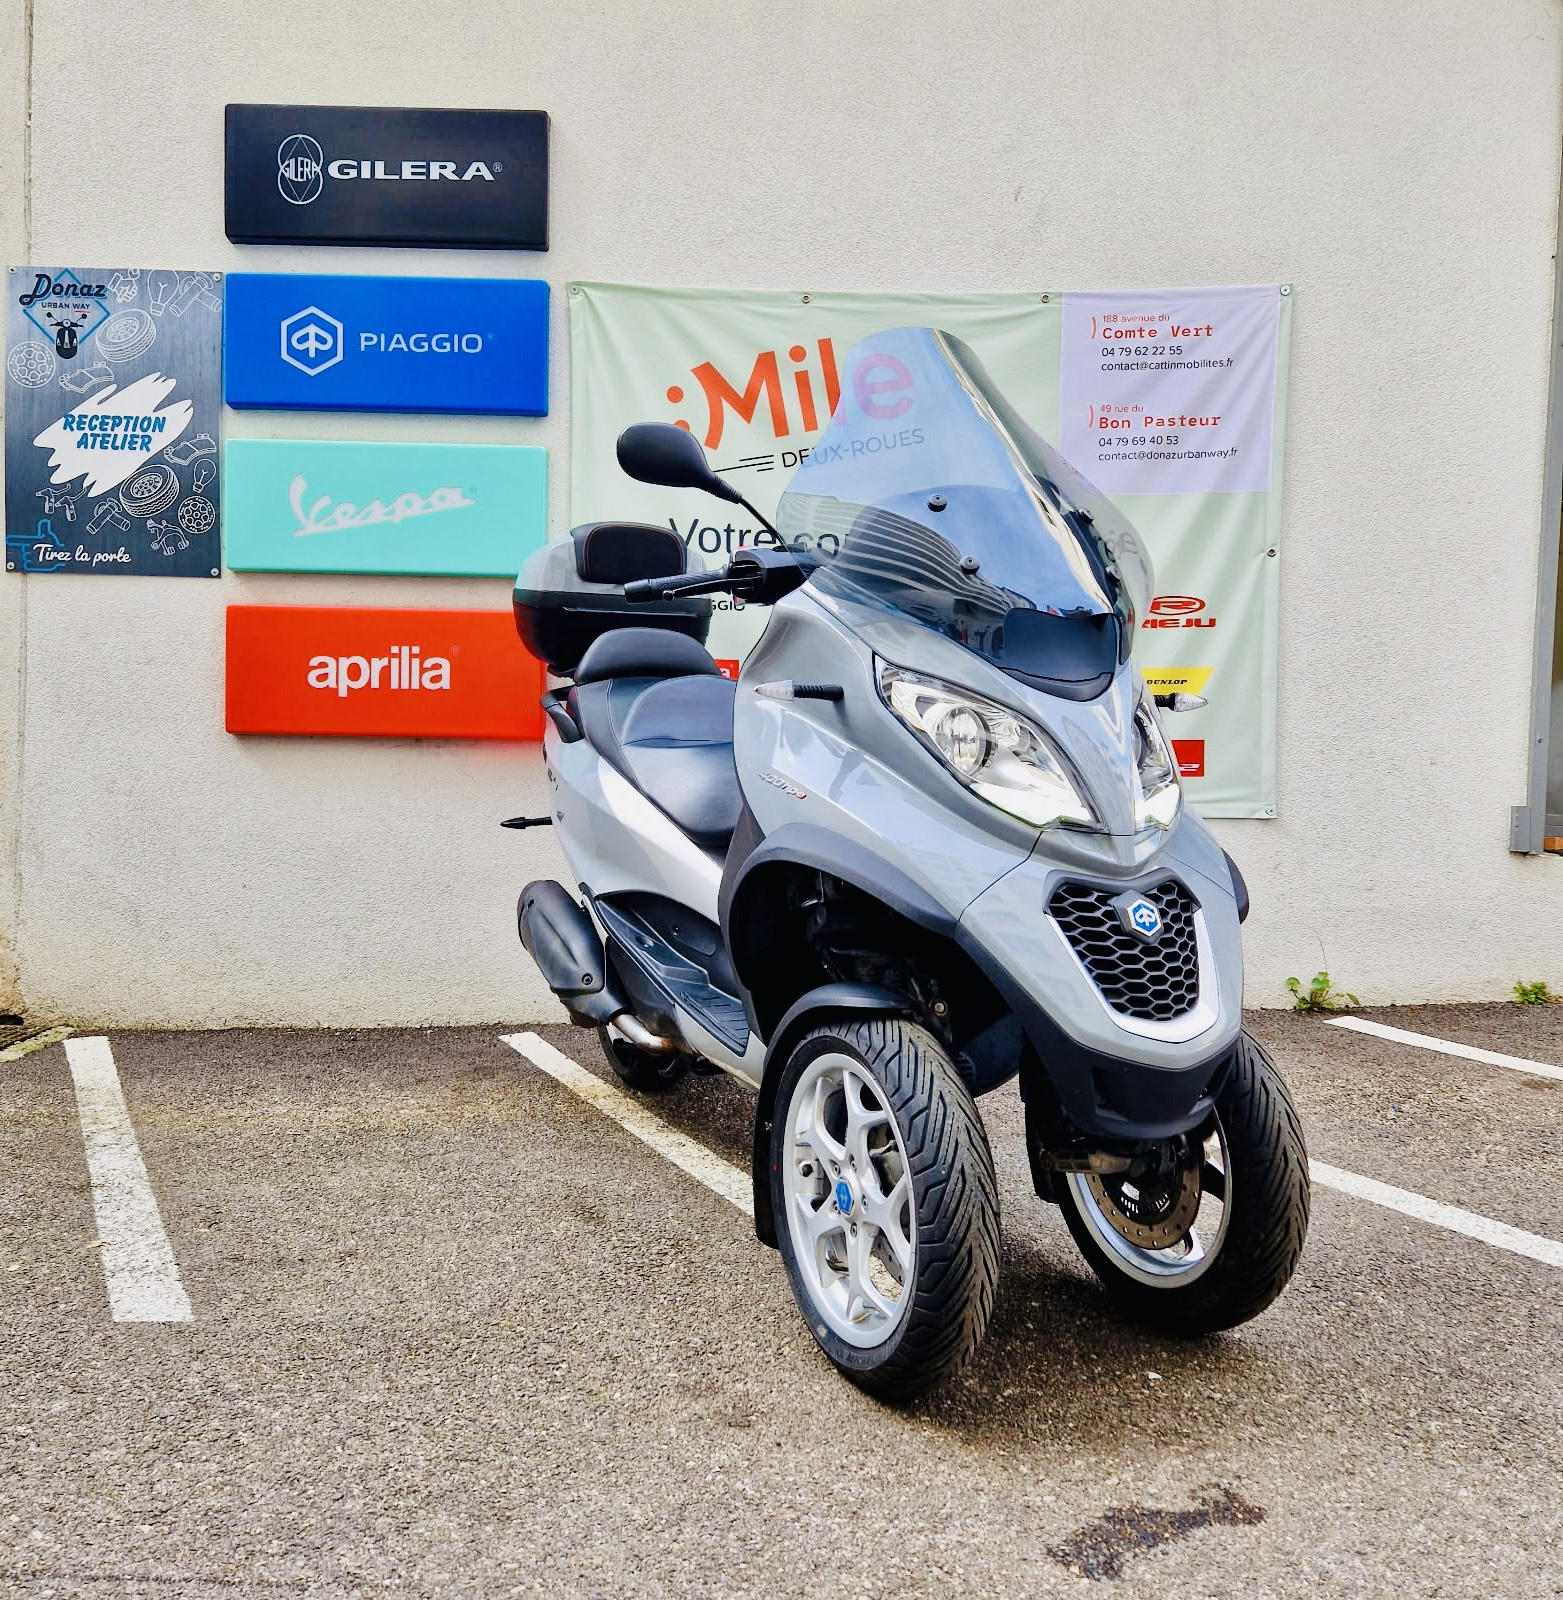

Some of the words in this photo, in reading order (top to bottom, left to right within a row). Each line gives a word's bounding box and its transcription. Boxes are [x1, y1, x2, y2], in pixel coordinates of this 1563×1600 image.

[19, 273, 107, 305] Donaz
[41, 301, 71, 310] URBAN
[1102, 314, 1118, 323] 188
[1121, 314, 1156, 322] avenue
[1158, 313, 1170, 322] du
[1102, 327, 1158, 339] Comte
[1171, 325, 1213, 338] Vert
[359, 332, 483, 354] PIAGGIO
[1101, 347, 1116, 357] 04
[1118, 347, 1132, 356] 79
[1134, 346, 1149, 356] 62
[1151, 346, 1166, 355] 22
[1169, 346, 1183, 355] 55
[1100, 405, 1112, 413] 49
[1132, 404, 1144, 413] du
[63, 414, 166, 433] RECEPTION
[1099, 417, 1131, 429] Bon
[1144, 415, 1222, 428] Pasteur
[76, 433, 152, 453] ATELIER
[781, 428, 925, 468] DEUX-ROUES
[1098, 437, 1113, 447] 04
[1115, 437, 1129, 446] 79
[1131, 437, 1146, 446] 69
[1149, 436, 1164, 446] 40
[1166, 435, 1180, 445] 53
[1098, 447, 1238, 461] contact@donazurbanway.fr
[288, 473, 476, 538] Vespa
[33, 543, 72, 562] Tirez
[75, 546, 91, 562] la
[92, 547, 132, 567] porte
[307, 645, 451, 698] aprilia
